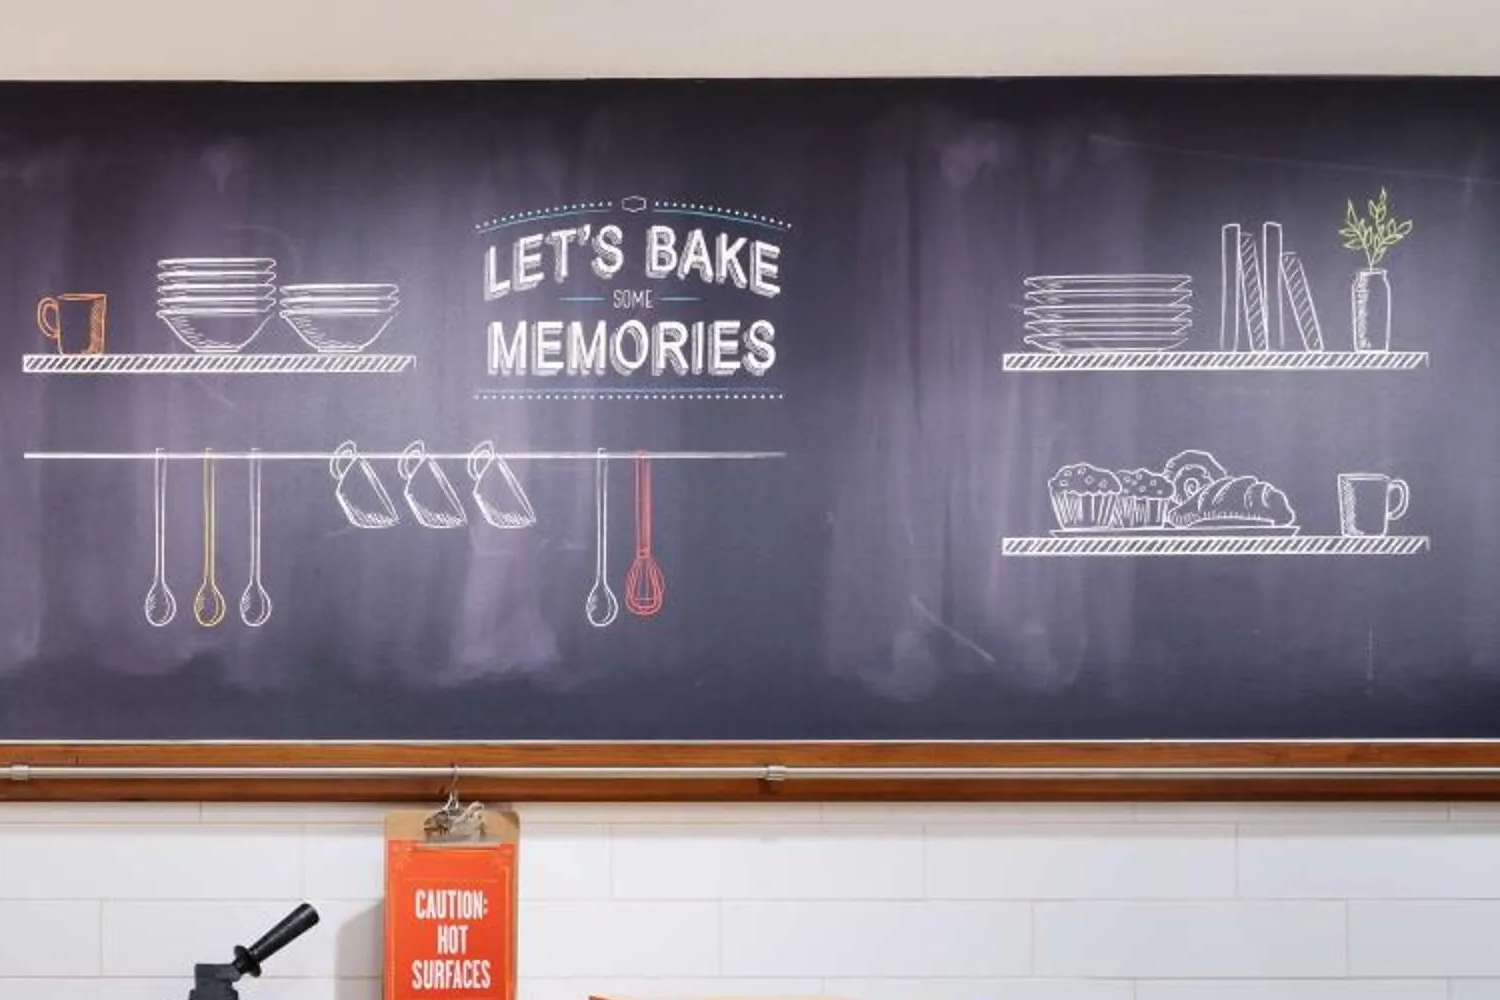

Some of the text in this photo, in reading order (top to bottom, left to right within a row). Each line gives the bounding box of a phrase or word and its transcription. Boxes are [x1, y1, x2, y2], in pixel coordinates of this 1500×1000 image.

[483, 224, 781, 300] LET'S BAKE
[613, 289, 654, 308] SOME
[487, 319, 776, 377] MEMORIES
[415, 889, 488, 919] CAUTION:
[437, 925, 468, 954] HOT
[412, 959, 491, 990] SURFACES
